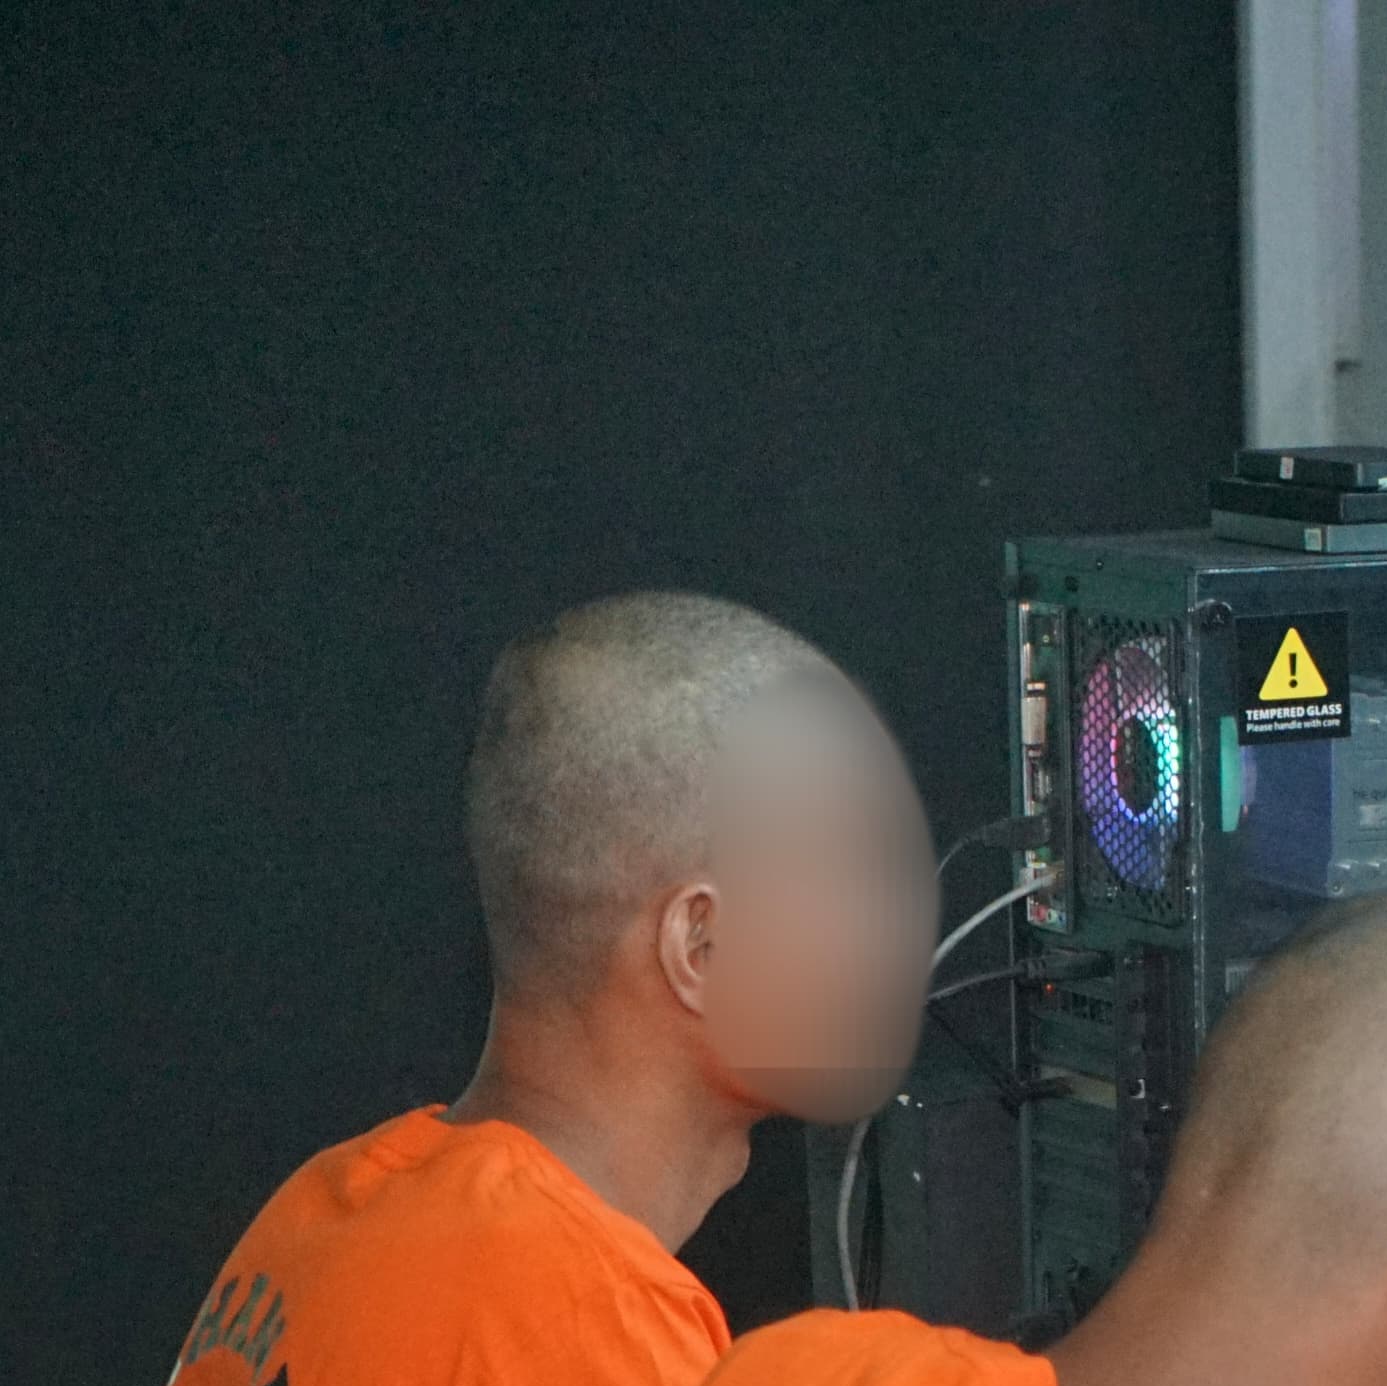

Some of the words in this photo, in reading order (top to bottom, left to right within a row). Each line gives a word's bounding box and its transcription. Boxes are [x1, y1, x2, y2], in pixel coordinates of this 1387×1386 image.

[1245, 706, 1304, 720] TEMPERED
[1306, 704, 1343, 717] GLASS
[1246, 722, 1273, 732] Please
[1273, 720, 1303, 731] handle
[1303, 719, 1321, 729] with
[1322, 718, 1341, 727] care
